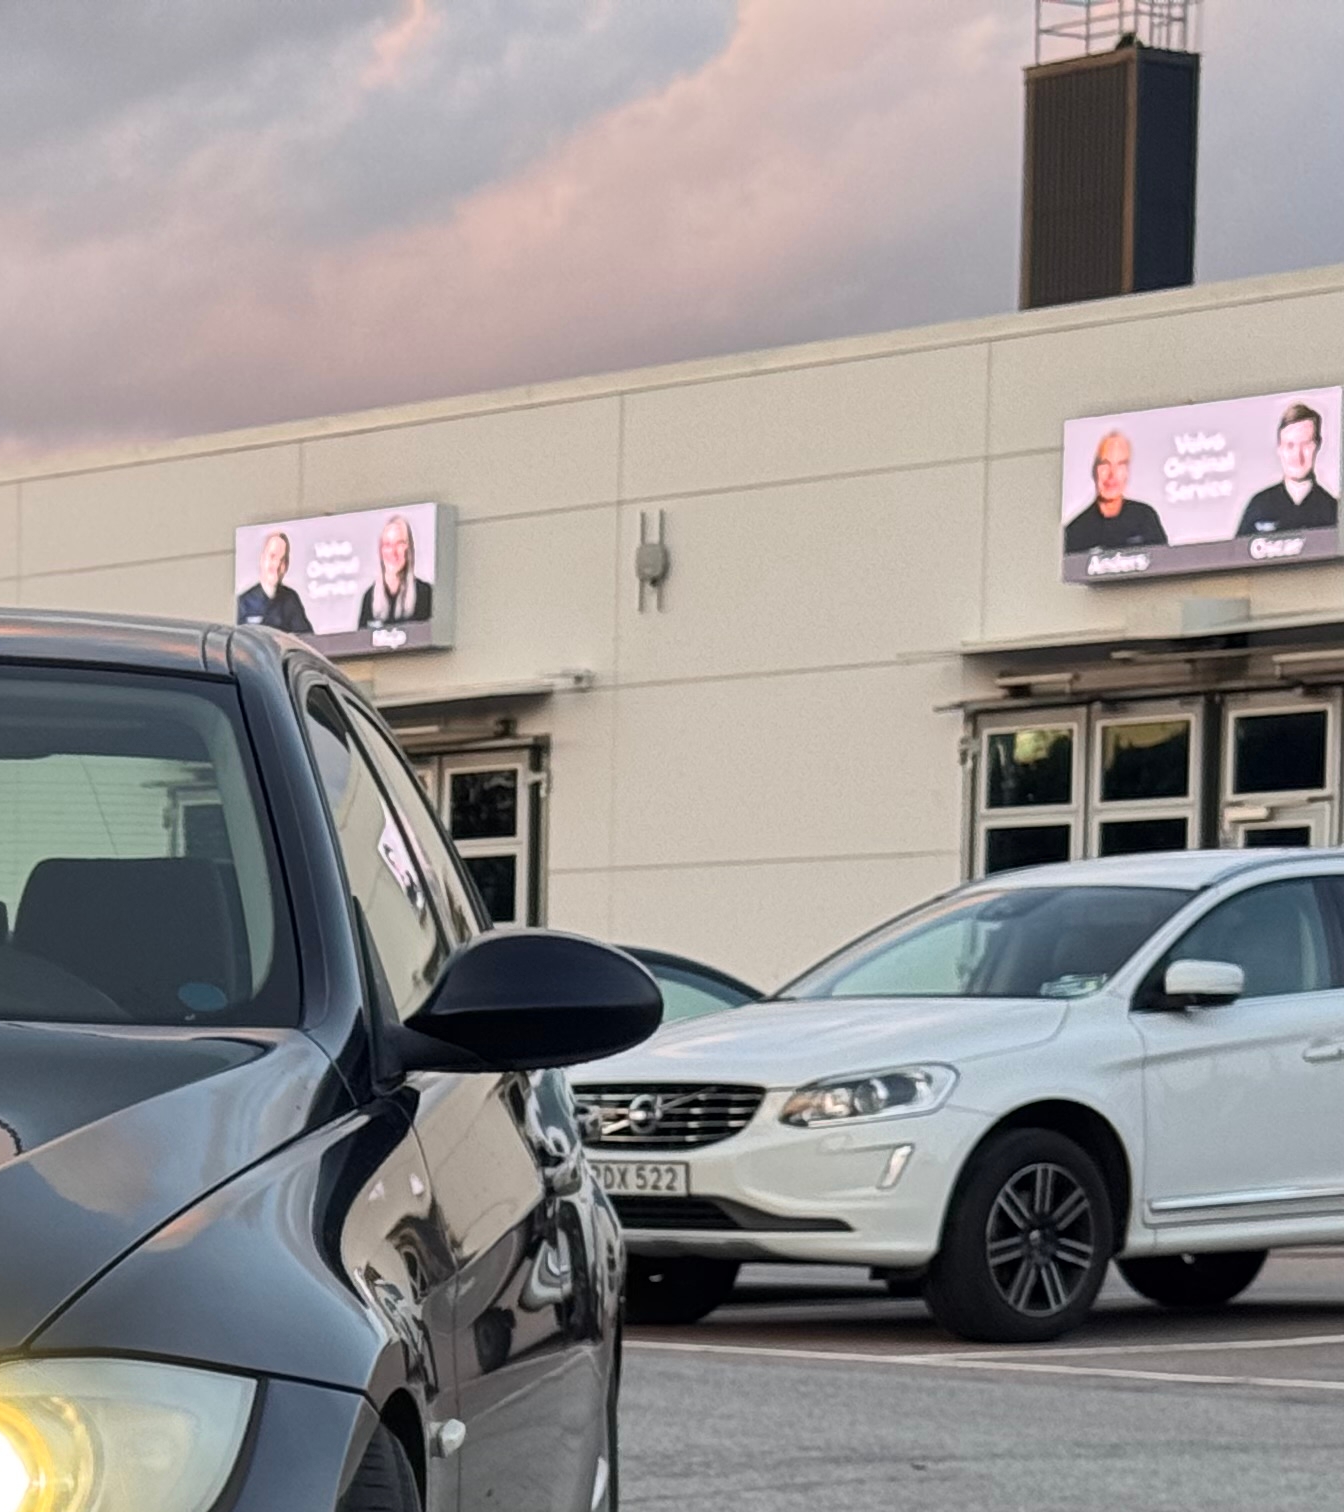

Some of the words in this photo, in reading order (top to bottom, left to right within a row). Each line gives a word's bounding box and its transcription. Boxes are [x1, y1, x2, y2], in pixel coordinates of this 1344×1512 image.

[1174, 430, 1227, 455] Volvo
[1163, 450, 1236, 481] Original
[1164, 479, 1234, 504] Service
[635, 1164, 679, 1191] 522
